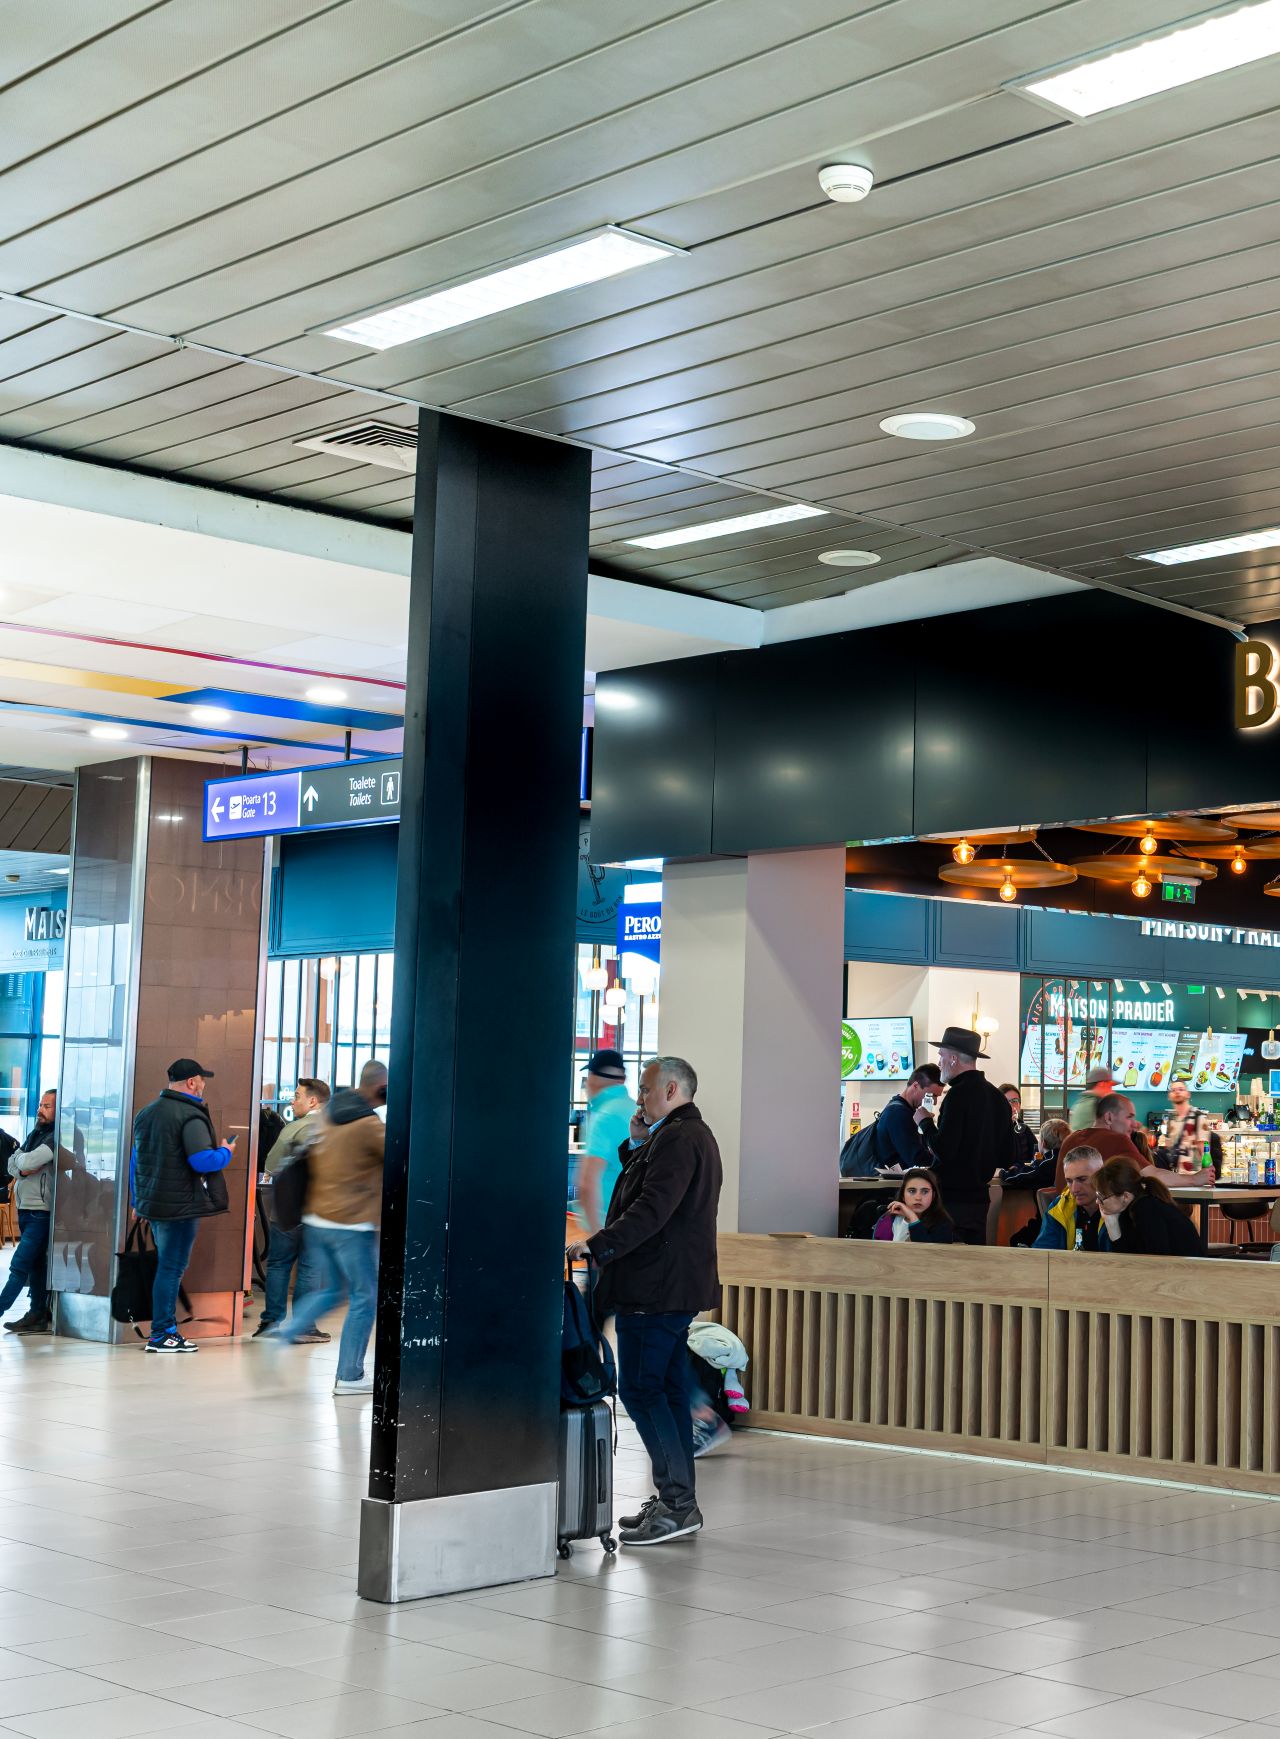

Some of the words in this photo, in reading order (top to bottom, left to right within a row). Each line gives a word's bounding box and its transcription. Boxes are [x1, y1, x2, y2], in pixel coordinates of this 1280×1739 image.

[349, 776, 376, 790] Toalete
[242, 794, 262, 805] Poarta
[262, 791, 277, 816] 13
[349, 793, 372, 807] Toilets
[242, 808, 256, 818] Gate
[24, 907, 65, 940] MAIS
[624, 916, 661, 933] PERO
[1113, 1000, 1174, 1022] PRADIER
